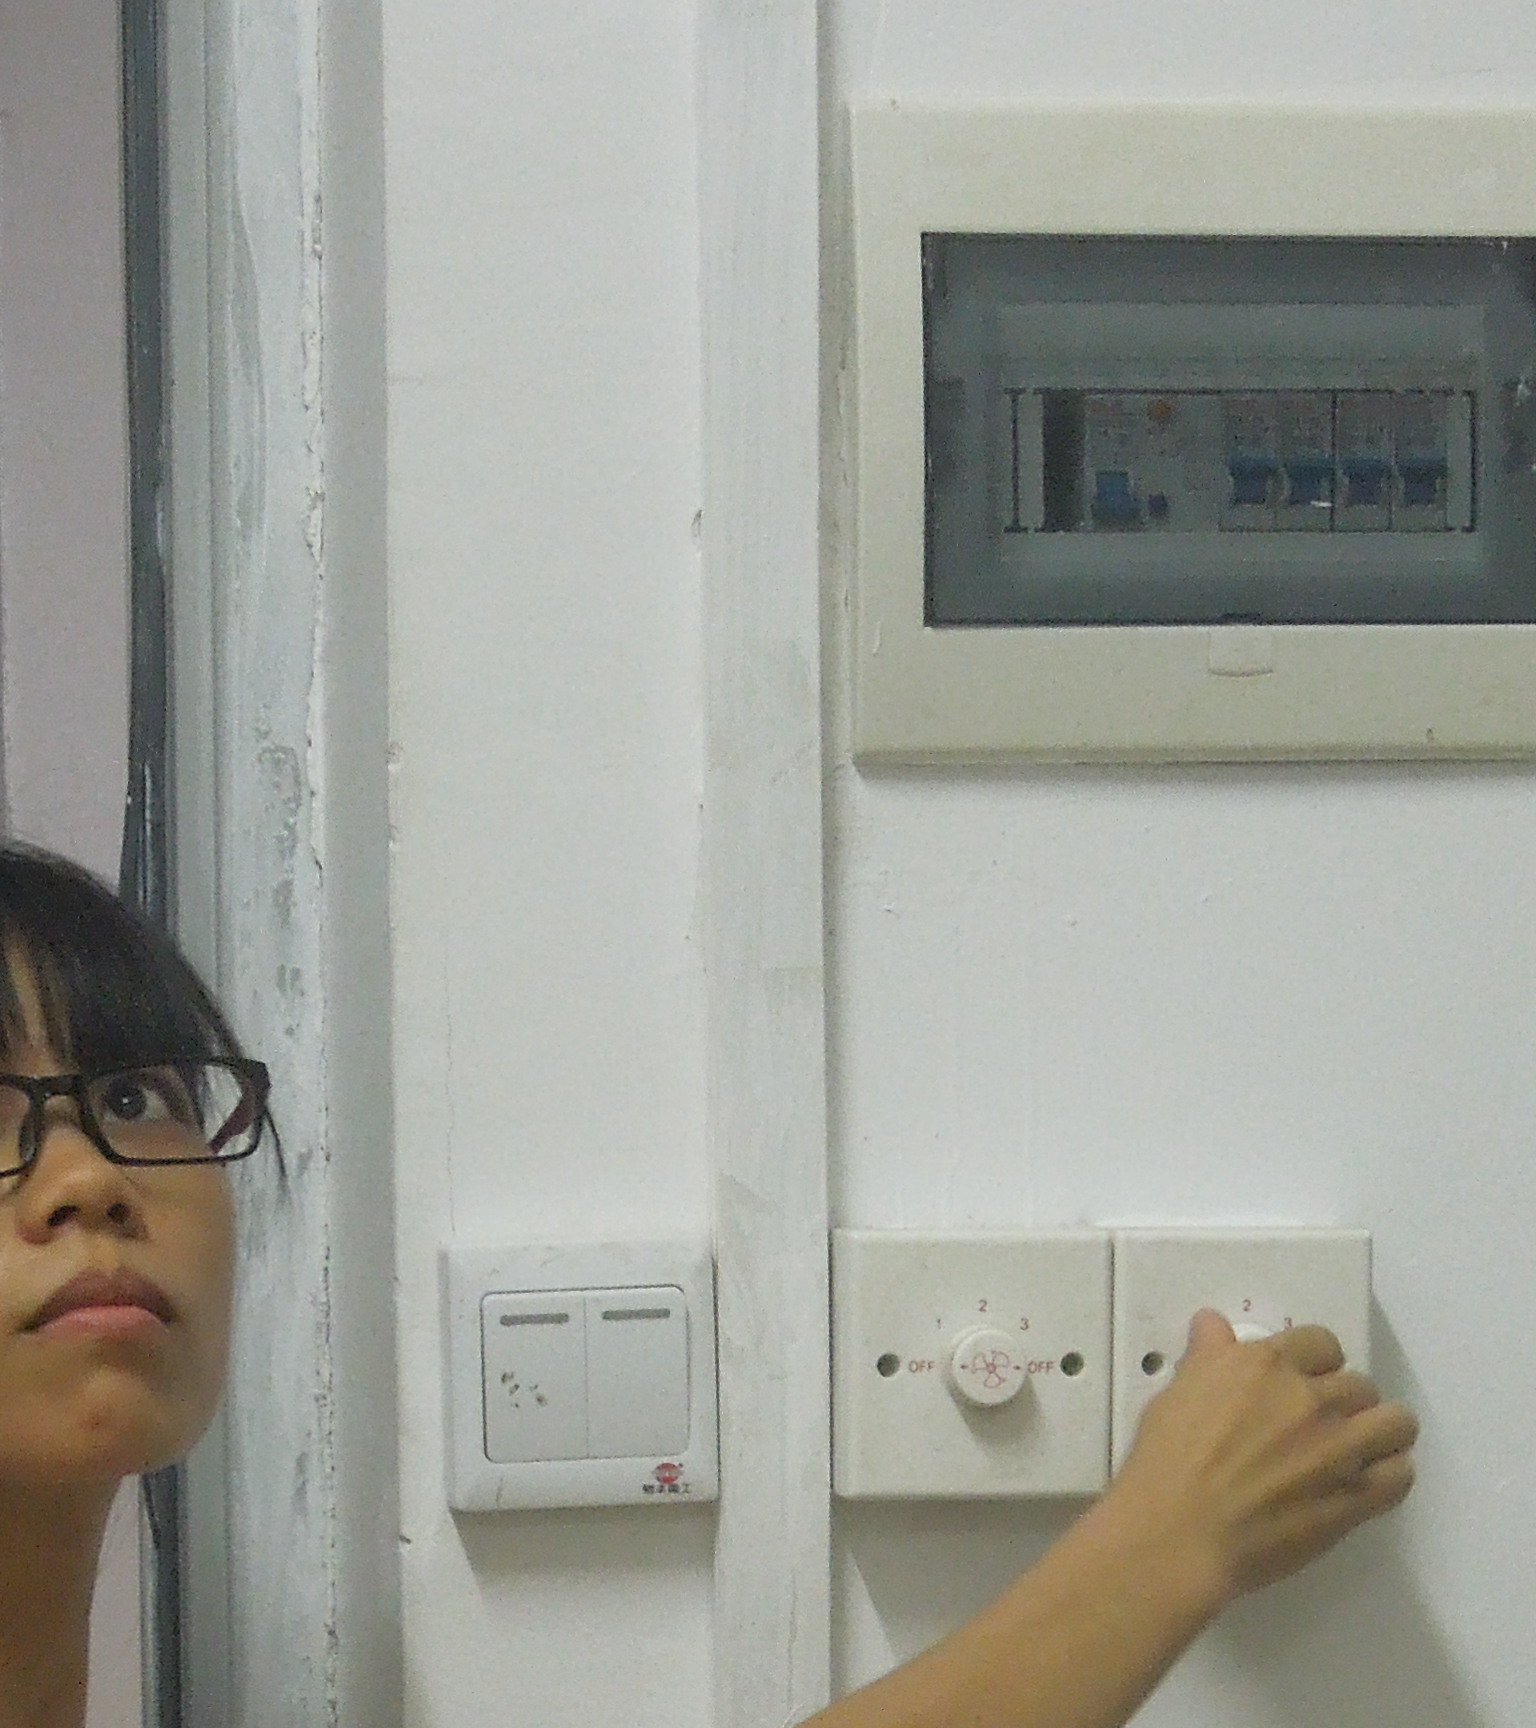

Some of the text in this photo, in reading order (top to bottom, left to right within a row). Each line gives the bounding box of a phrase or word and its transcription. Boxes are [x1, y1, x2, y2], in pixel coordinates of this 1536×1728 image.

[978, 1299, 988, 1313] 2
[1243, 1299, 1252, 1312] 2
[1020, 1317, 1030, 1331] 3
[909, 1360, 935, 1373] OFF
[1027, 1360, 1055, 1374] OFF
